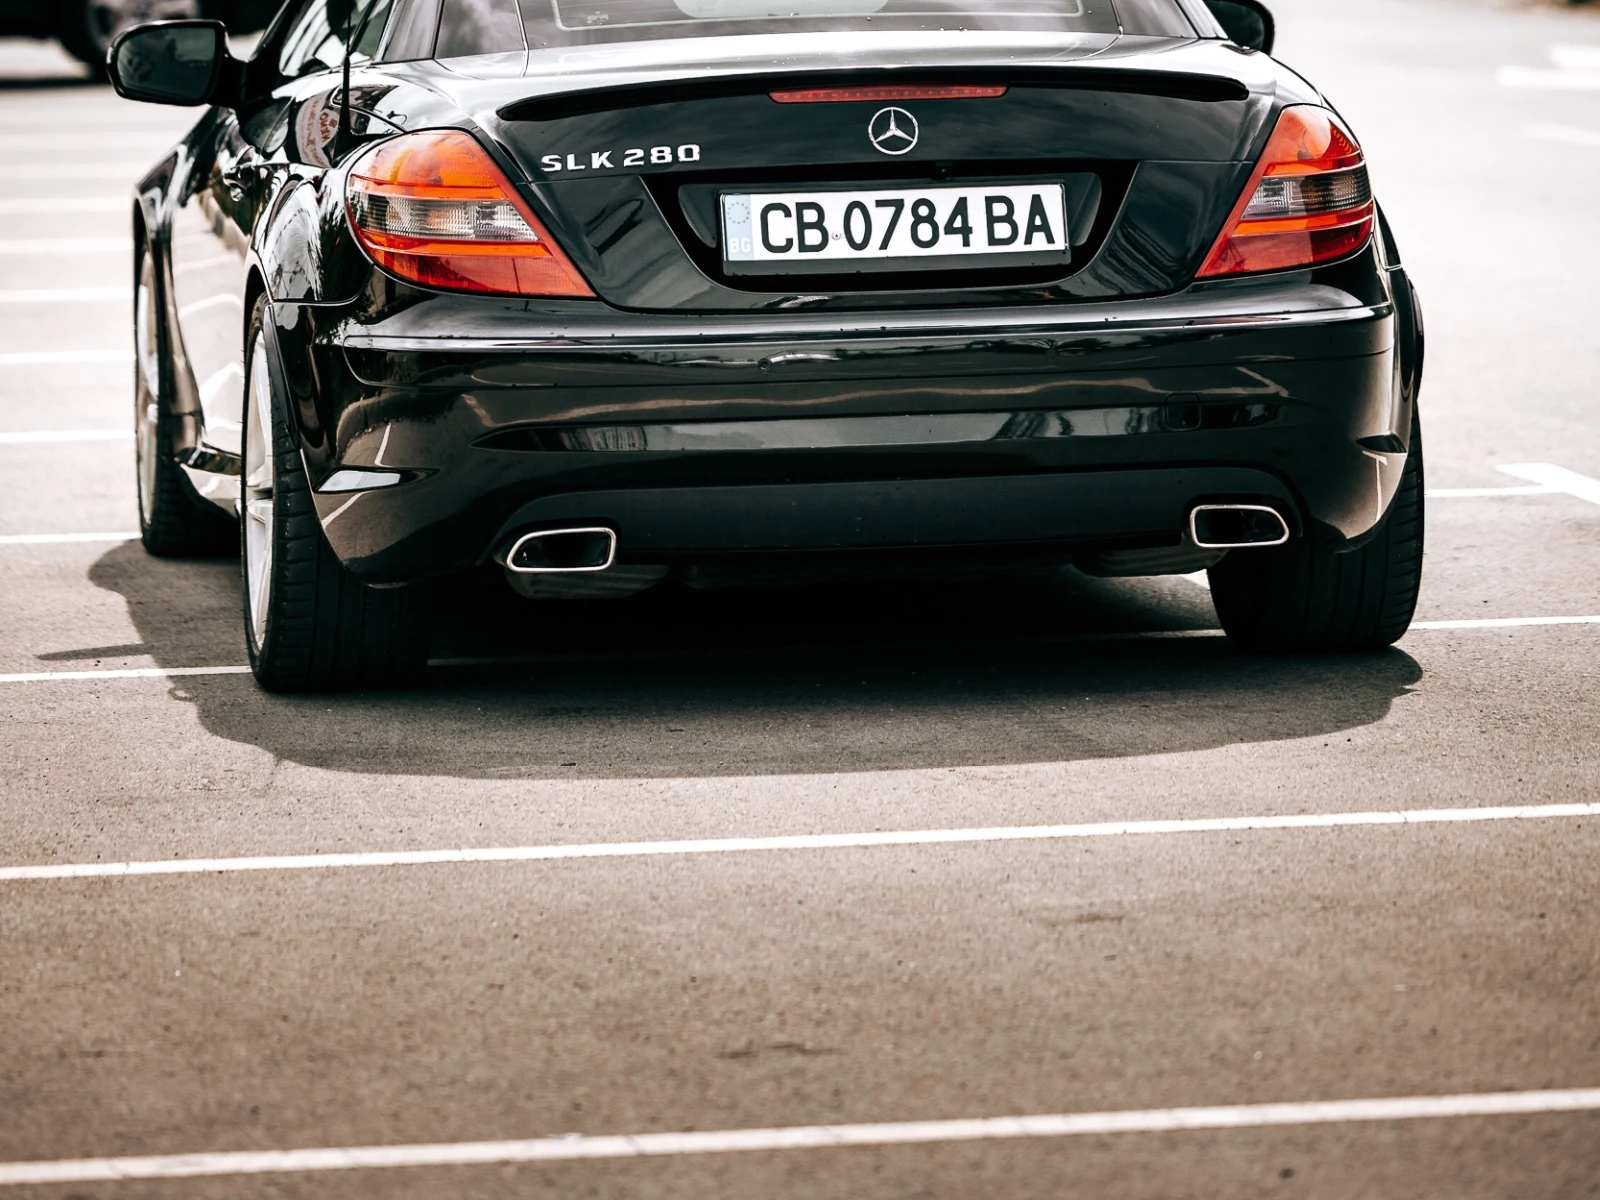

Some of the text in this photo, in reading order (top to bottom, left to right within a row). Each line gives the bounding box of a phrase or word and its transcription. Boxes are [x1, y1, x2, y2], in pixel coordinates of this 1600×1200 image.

[541, 144, 701, 172] SLK 280
[759, 193, 1056, 253] CB 0784 BA
[729, 236, 751, 254] BG
